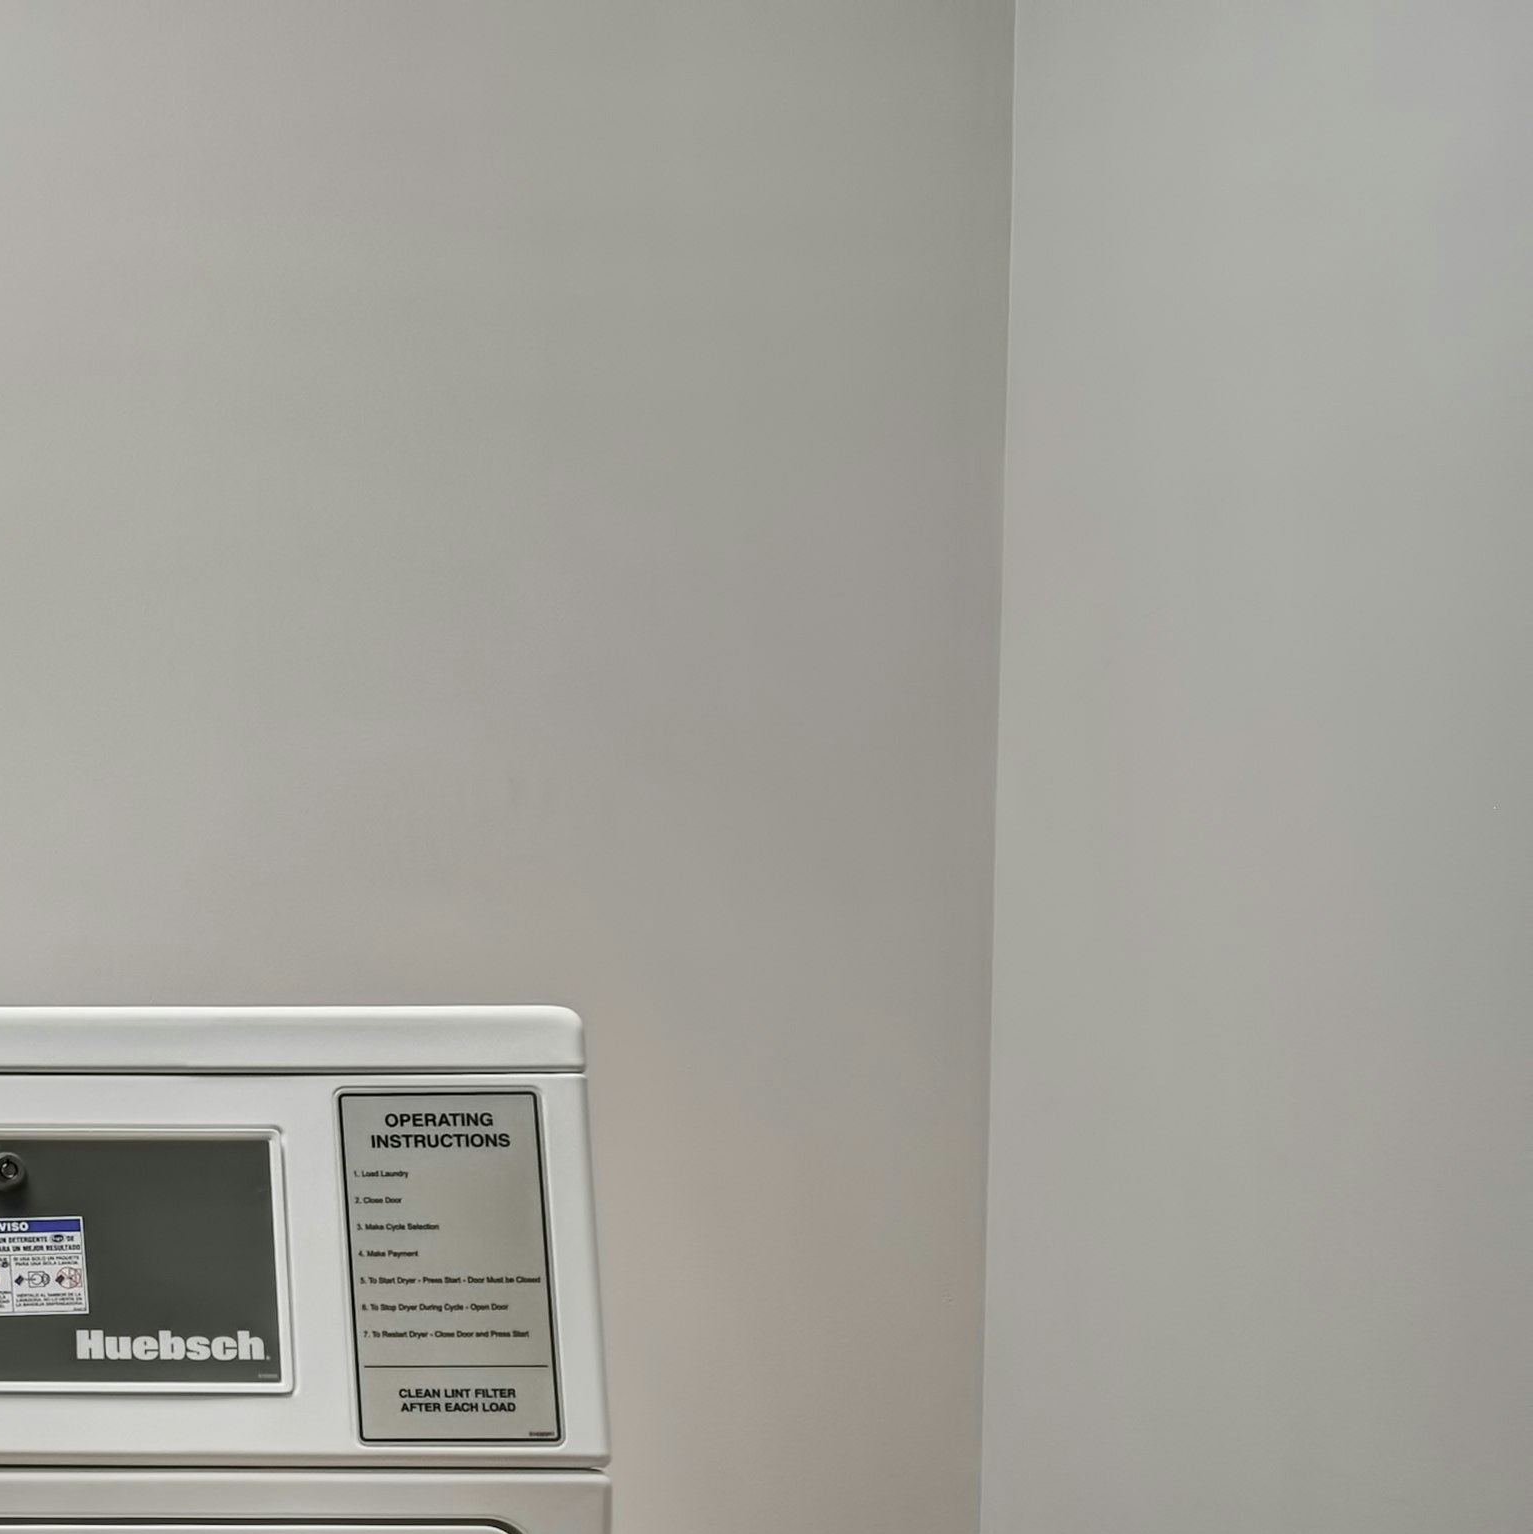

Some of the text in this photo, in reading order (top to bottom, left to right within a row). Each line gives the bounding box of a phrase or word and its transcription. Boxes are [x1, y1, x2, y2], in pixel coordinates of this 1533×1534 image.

[385, 1113, 493, 1127] OPERATING
[371, 1133, 510, 1148] INSTRUCTIONS
[76, 1329, 265, 1361] Huebsch
[399, 1388, 516, 1398] CLEAN LINT FILTER
[401, 1402, 516, 1412] AFTER EACH LOAD
